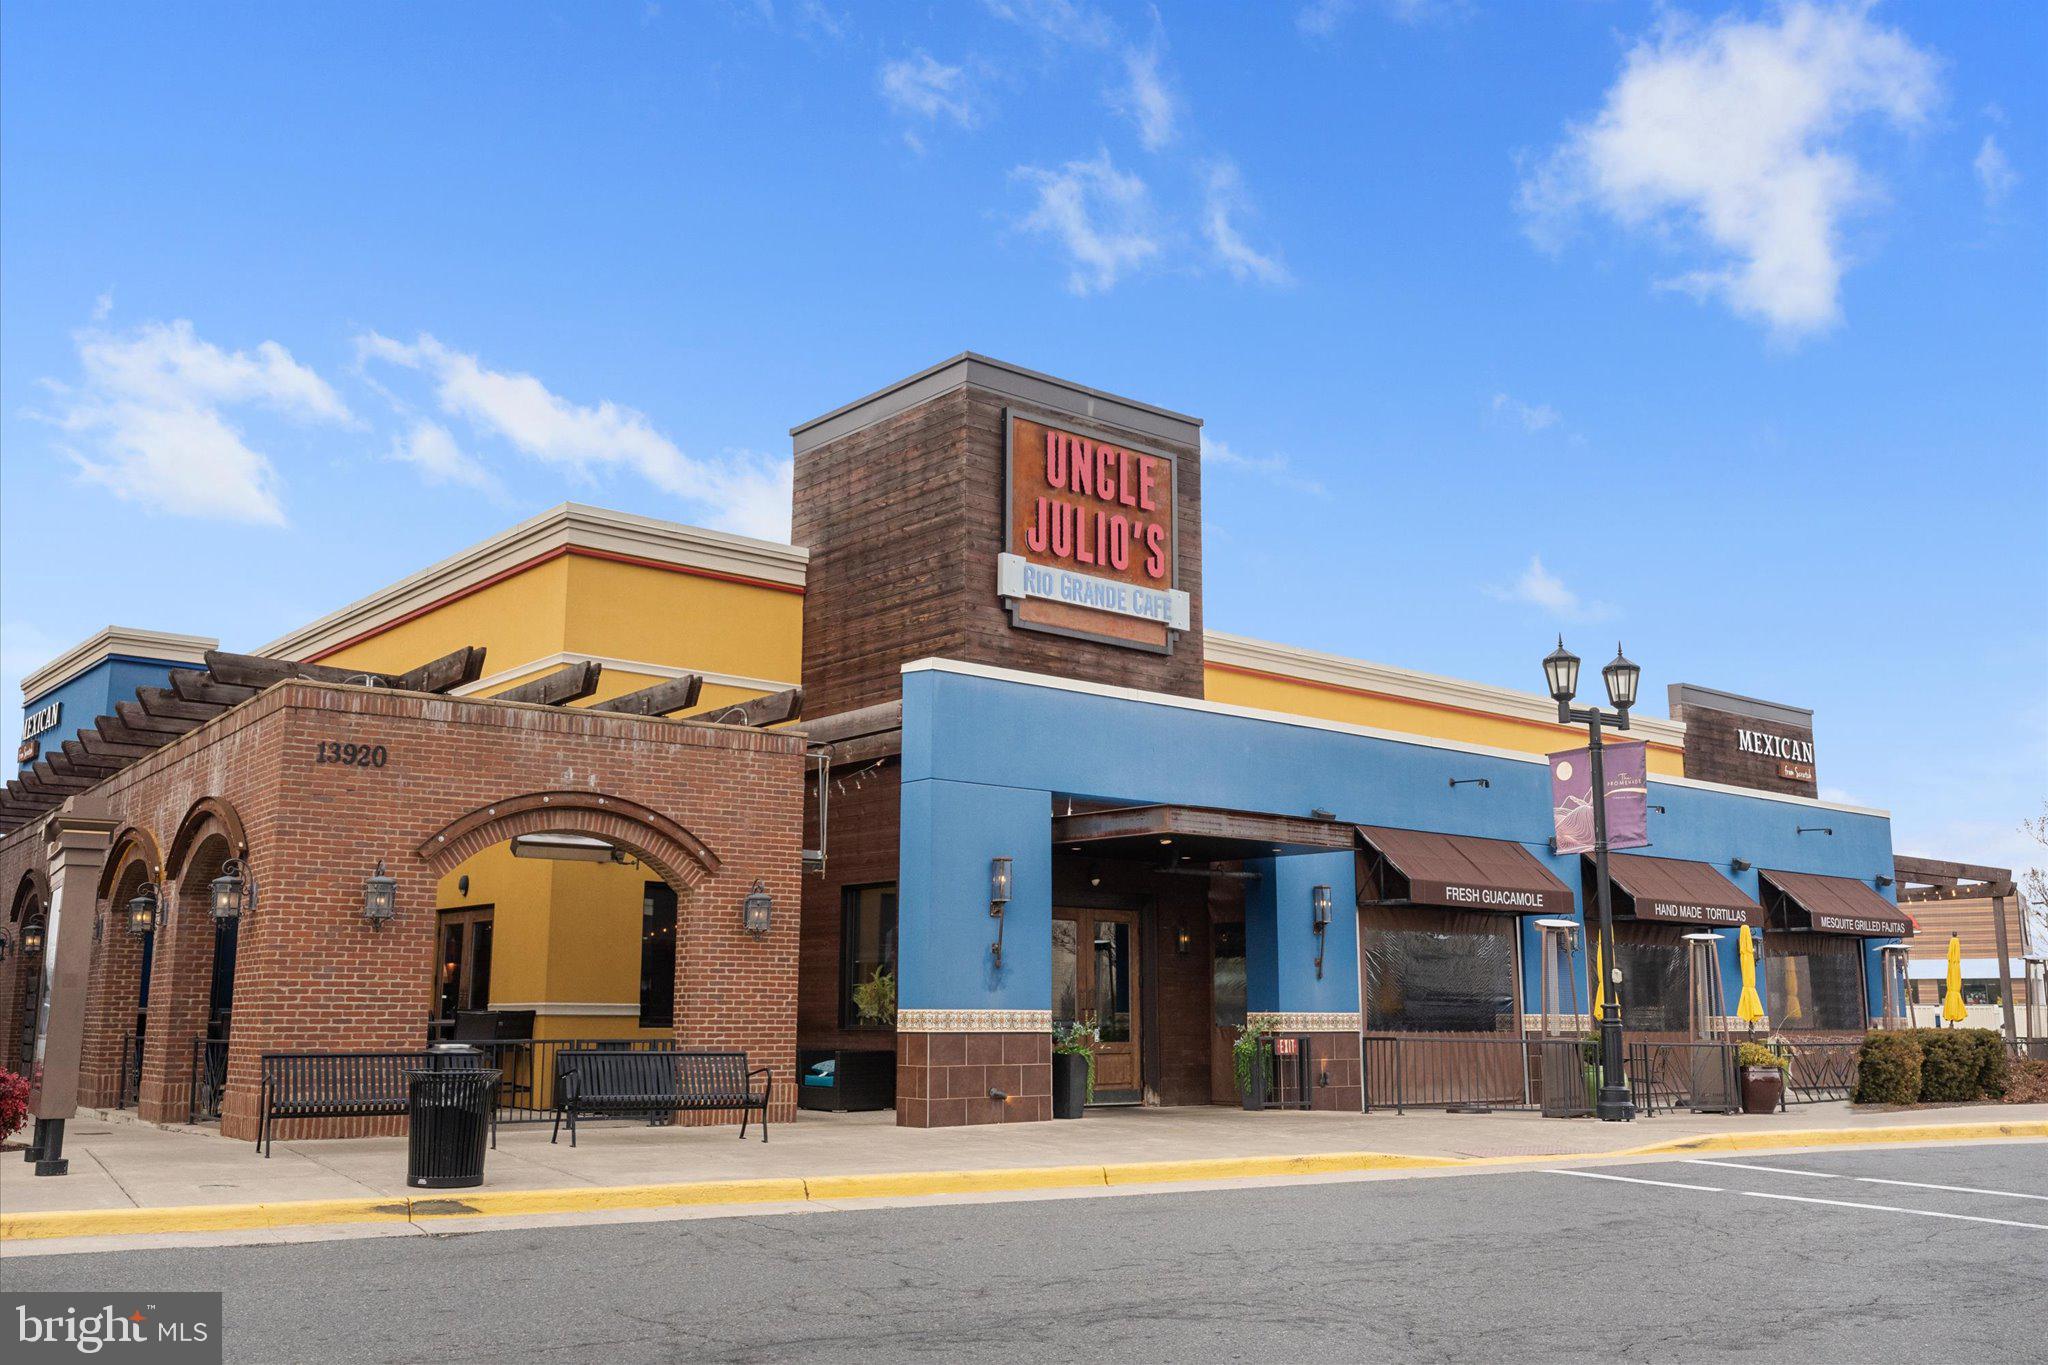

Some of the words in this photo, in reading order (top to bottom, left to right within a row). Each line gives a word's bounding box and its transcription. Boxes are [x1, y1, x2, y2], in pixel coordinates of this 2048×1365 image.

[1046, 431, 1156, 511] UNCLE
[1026, 496, 1165, 579] JULIO'S
[1023, 565, 1054, 597] RIO
[1060, 575, 1127, 610] GRANDE
[317, 741, 387, 767] 13920
[1738, 729, 1813, 763] MEXICAN
[1446, 886, 1480, 902] FRESH
[1482, 889, 1543, 907] GUACAMOLE
[1654, 903, 1678, 917] HAND
[1679, 905, 1703, 919] MADE
[1705, 907, 1747, 922] TORTILLAS
[1820, 916, 1854, 930] MESQUITE
[1854, 919, 1881, 932] GRILLED
[1881, 921, 1906, 933] FAJITAS
[1280, 1039, 1296, 1054] EXIT
